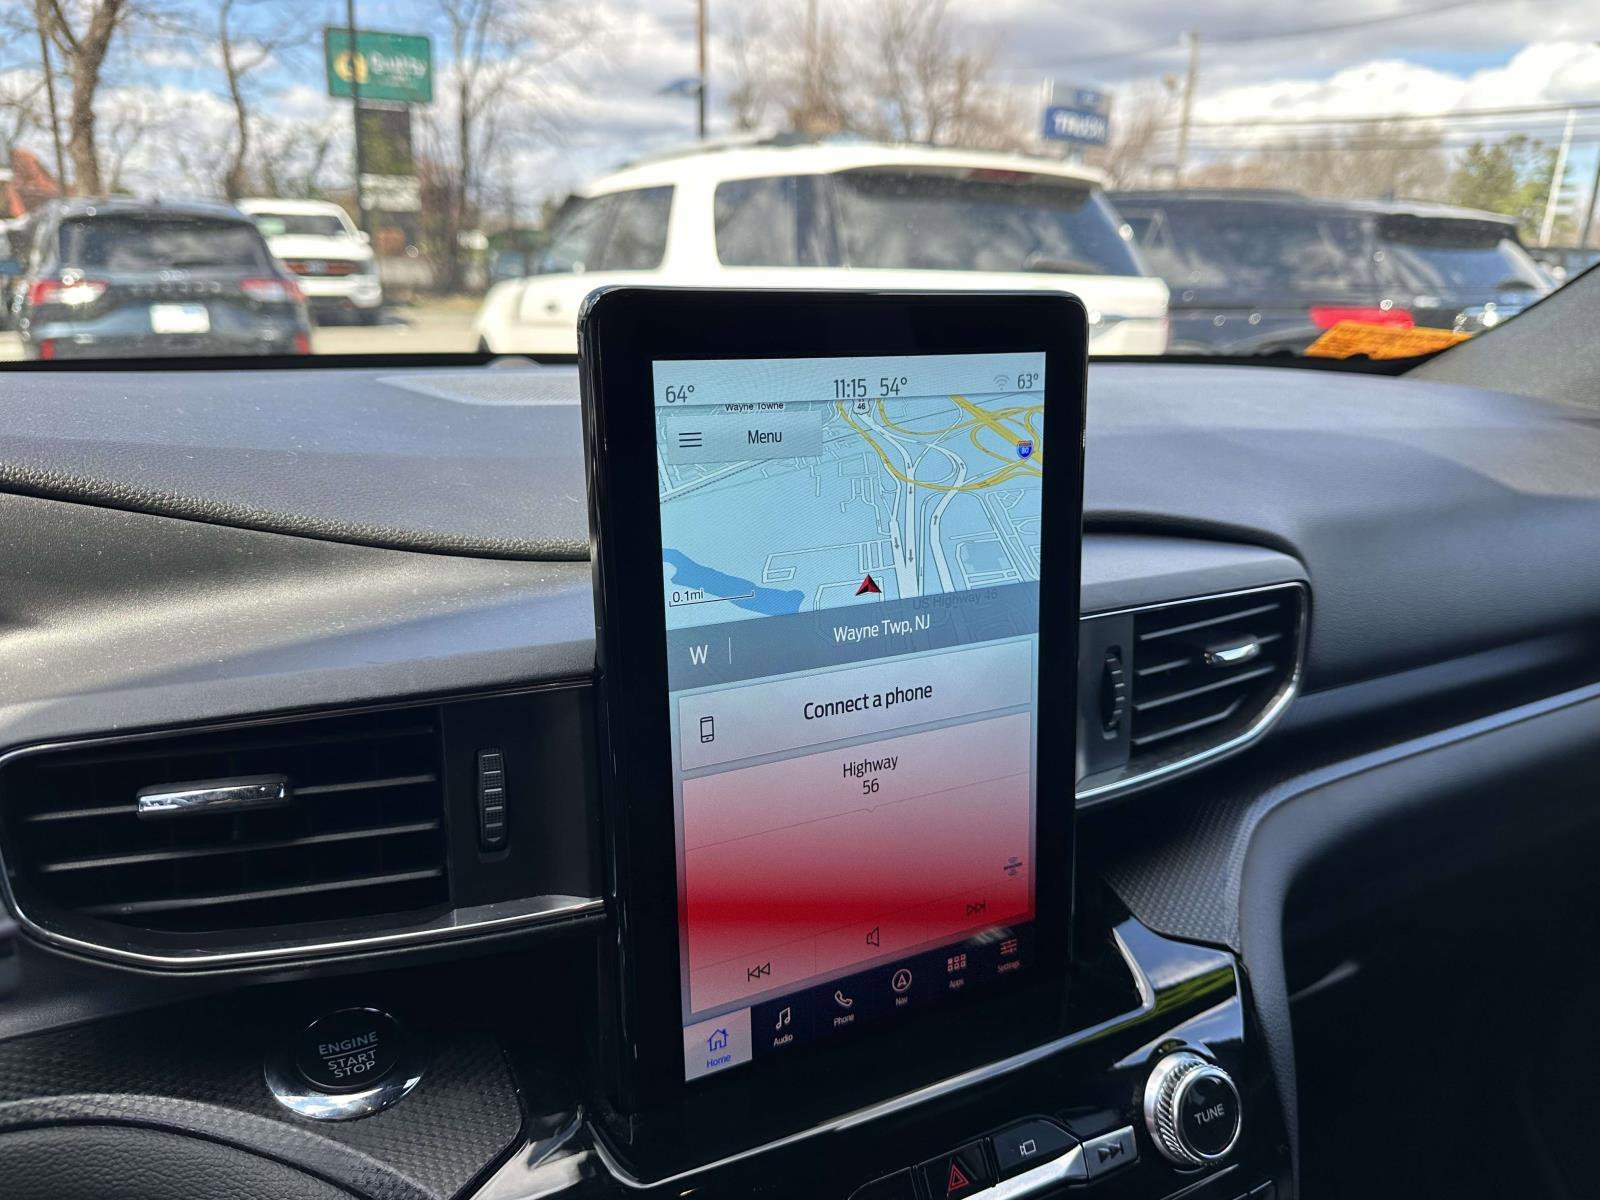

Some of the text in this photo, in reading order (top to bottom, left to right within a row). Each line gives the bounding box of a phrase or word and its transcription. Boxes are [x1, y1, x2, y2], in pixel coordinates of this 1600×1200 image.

[833, 376, 908, 399] 11:15 54°
[1017, 372, 1039, 390] 63°
[665, 384, 695, 404] 64°
[725, 401, 784, 413] Wayne Towne
[857, 402, 866, 411] 46
[747, 429, 783, 445] Menu
[672, 587, 704, 603] 0.1mi
[833, 613, 931, 643] Wayne Twp, NJ
[689, 644, 709, 666] W
[803, 685, 933, 720] Connect a phone
[842, 755, 898, 778] Highway
[863, 778, 880, 795] 56
[948, 977, 965, 990] Apps
[895, 996, 909, 1008] Nav
[833, 1013, 856, 1028] Phone
[318, 1031, 379, 1056] ENGINE
[773, 1033, 794, 1048] Audio
[327, 1049, 377, 1071] START
[706, 1053, 732, 1069] Home
[333, 1060, 376, 1079] STOP
[1193, 1103, 1225, 1126] TUNE
